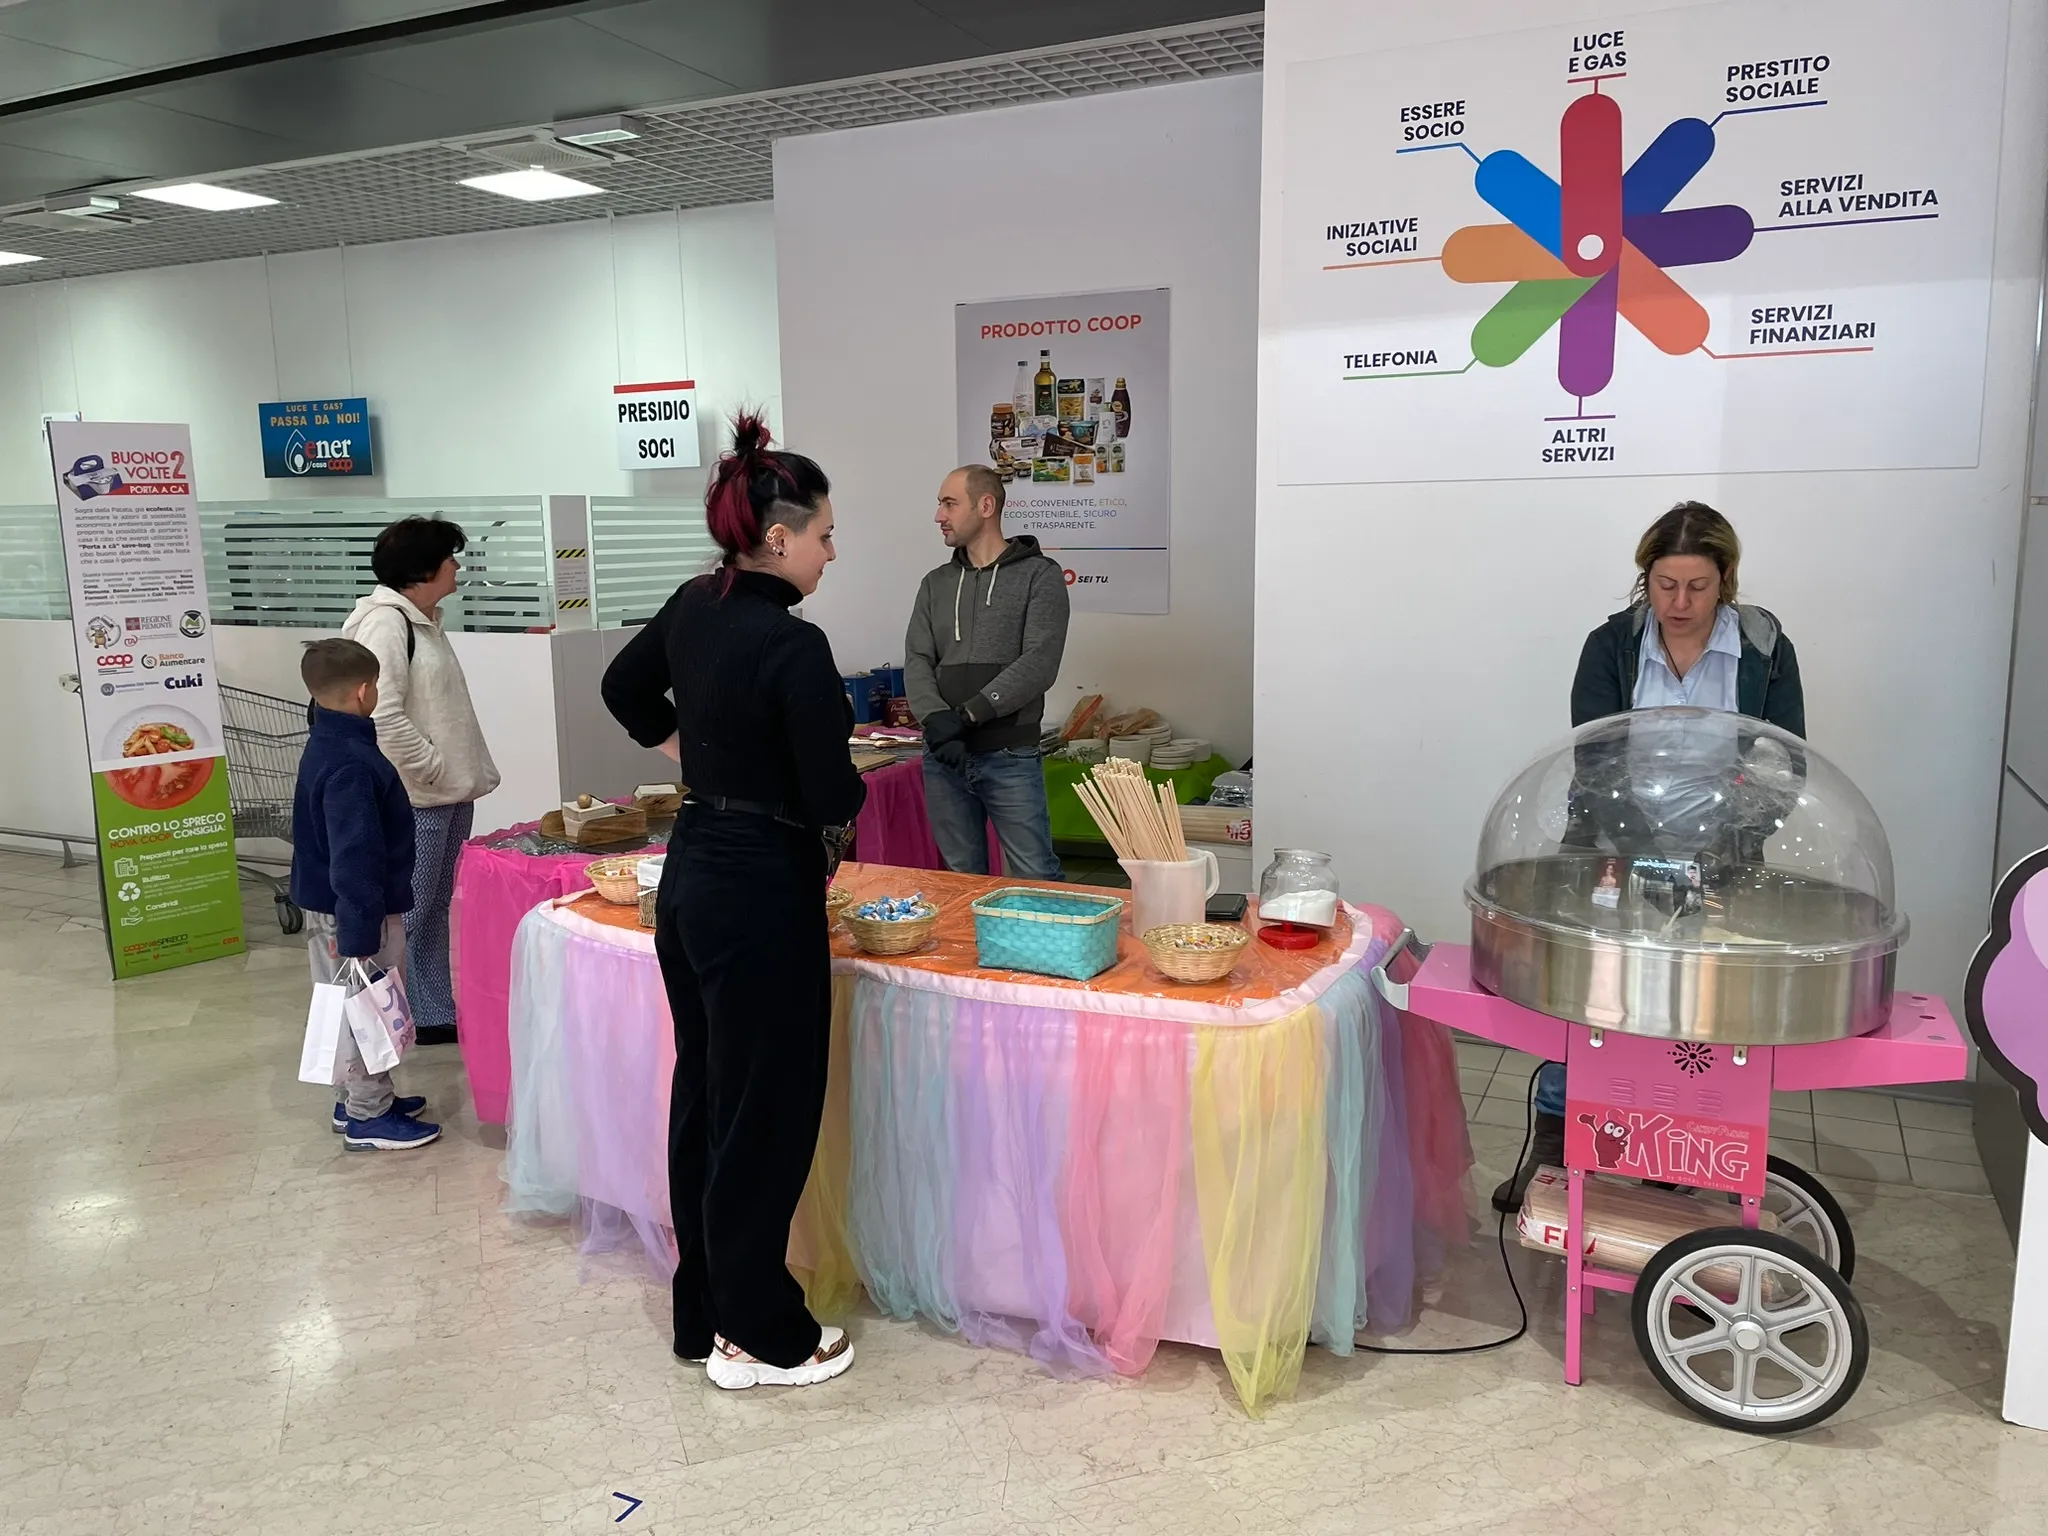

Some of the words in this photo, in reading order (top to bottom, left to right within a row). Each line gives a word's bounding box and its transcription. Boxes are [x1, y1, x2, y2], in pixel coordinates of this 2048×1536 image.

[1573, 30, 1624, 52] LUCE
[1569, 57, 1579, 73] E
[1584, 51, 1627, 70] GAS
[1727, 55, 1830, 82] PRESTITO
[1726, 77, 1819, 102] SOCIALE
[1401, 100, 1466, 122] ESSERE
[1404, 120, 1464, 141] SOCIO
[1781, 174, 1863, 196] SERVIZI
[1778, 198, 1832, 218] ALLA
[1838, 189, 1939, 212] VENDITA
[1327, 217, 1418, 240] INIZIATIVE
[1346, 236, 1417, 256] SOCIALI
[1751, 304, 1833, 324] SERVIZI
[981, 319, 1081, 339] PRODOTTO
[1087, 315, 1141, 332] COOP
[1750, 322, 1875, 344] FINANZIARI
[1344, 350, 1438, 369] TELEFONIA
[270, 416, 307, 426] PASSA
[315, 415, 330, 425] DA
[337, 413, 360, 424] NOI!
[618, 400, 689, 423] PRESIDIO
[1552, 428, 1606, 444] ALTRI
[305, 439, 351, 459] ener
[639, 438, 675, 459] SOCI
[1542, 446, 1614, 463] SERVIZI
[111, 451, 168, 464] BUONO
[171, 451, 186, 479] 2
[124, 467, 170, 479] VOLTE
[328, 459, 353, 472] coop
[130, 486, 158, 494] PORTA
[162, 486, 168, 494] A
[1031, 498, 1097, 507] CONVENIENTE,
[1099, 498, 1127, 507] ETICO,
[1004, 510, 1081, 519] ECOSOSTENIBILE,
[1084, 510, 1117, 518] SICURO
[1031, 521, 1097, 529] TRASPARENTE.
[1077, 576, 1094, 584] SEI
[141, 615, 172, 623] REGIONE
[142, 622, 173, 630] PIEMONTE
[97, 654, 133, 668] coop
[160, 657, 205, 667] Alimentare
[164, 673, 203, 690] Cuki
[108, 823, 160, 840] CONTRO
[164, 820, 180, 831] LO
[183, 812, 226, 828] SPRECO
[140, 833, 171, 844] COOP
